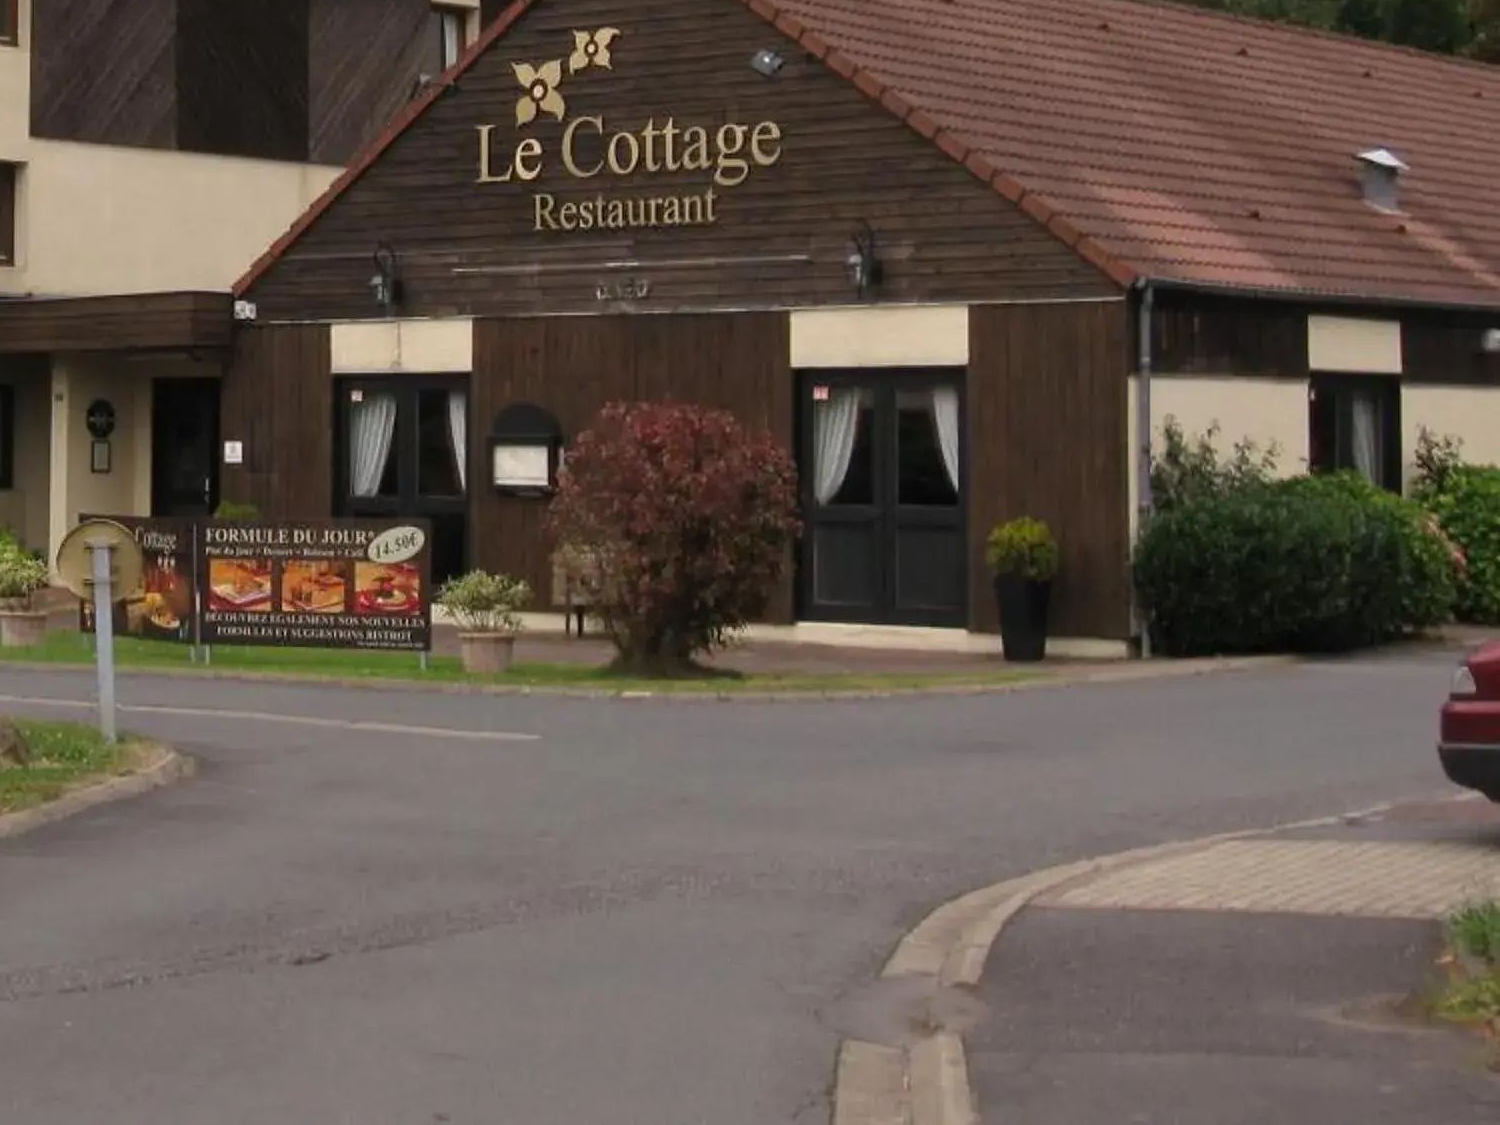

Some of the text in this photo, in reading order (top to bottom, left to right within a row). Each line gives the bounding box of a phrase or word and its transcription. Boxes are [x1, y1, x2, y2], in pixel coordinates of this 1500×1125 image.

[474, 115, 783, 187] Le Cottage
[532, 188, 719, 232] Restaurant
[205, 527, 289, 544] FORMULE
[293, 528, 317, 544] DU
